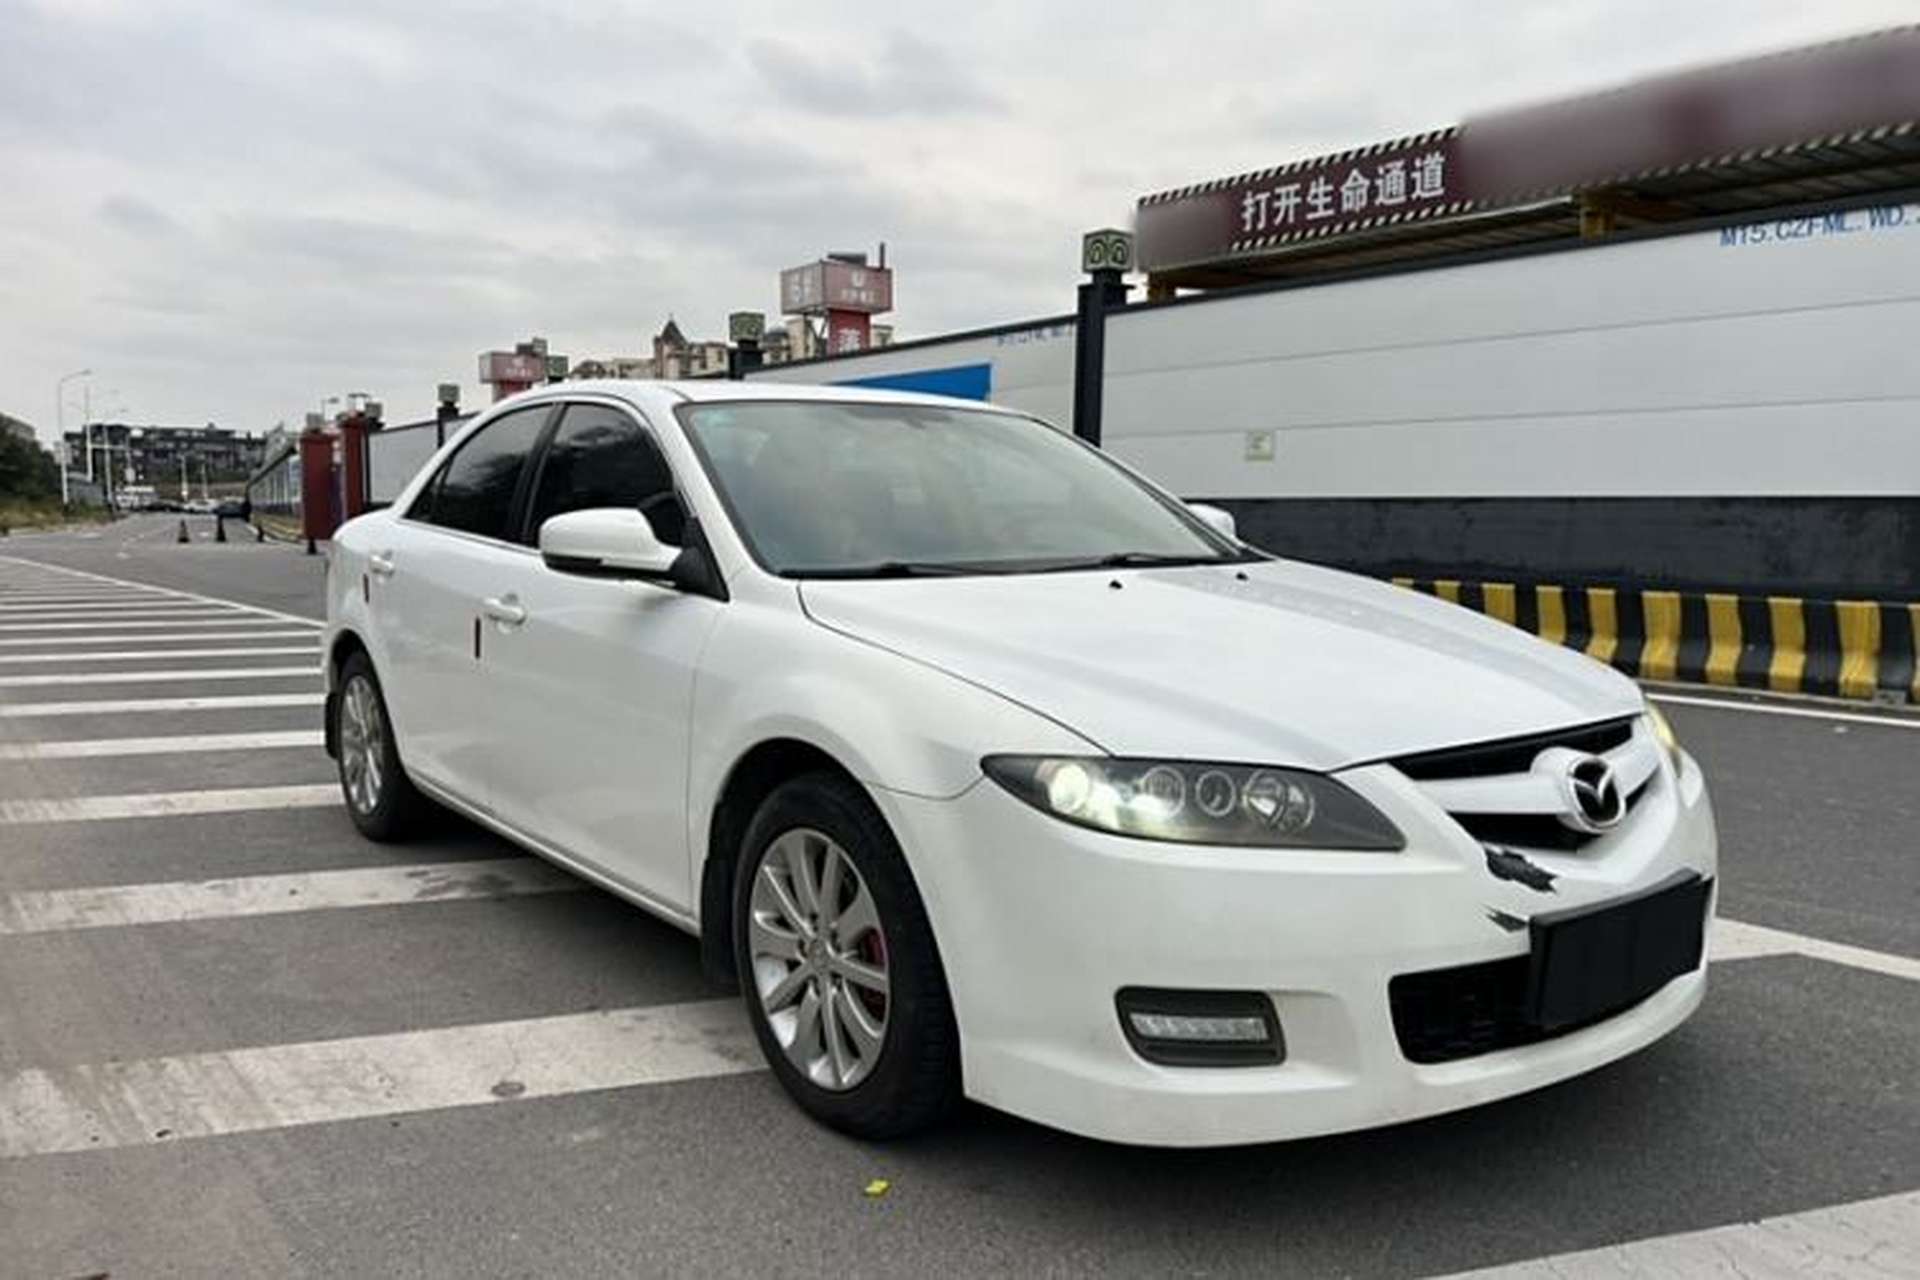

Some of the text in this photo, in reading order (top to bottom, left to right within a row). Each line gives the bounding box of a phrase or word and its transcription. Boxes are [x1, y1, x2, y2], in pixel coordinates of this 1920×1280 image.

[1243, 152, 1446, 231] 打开生命通道
